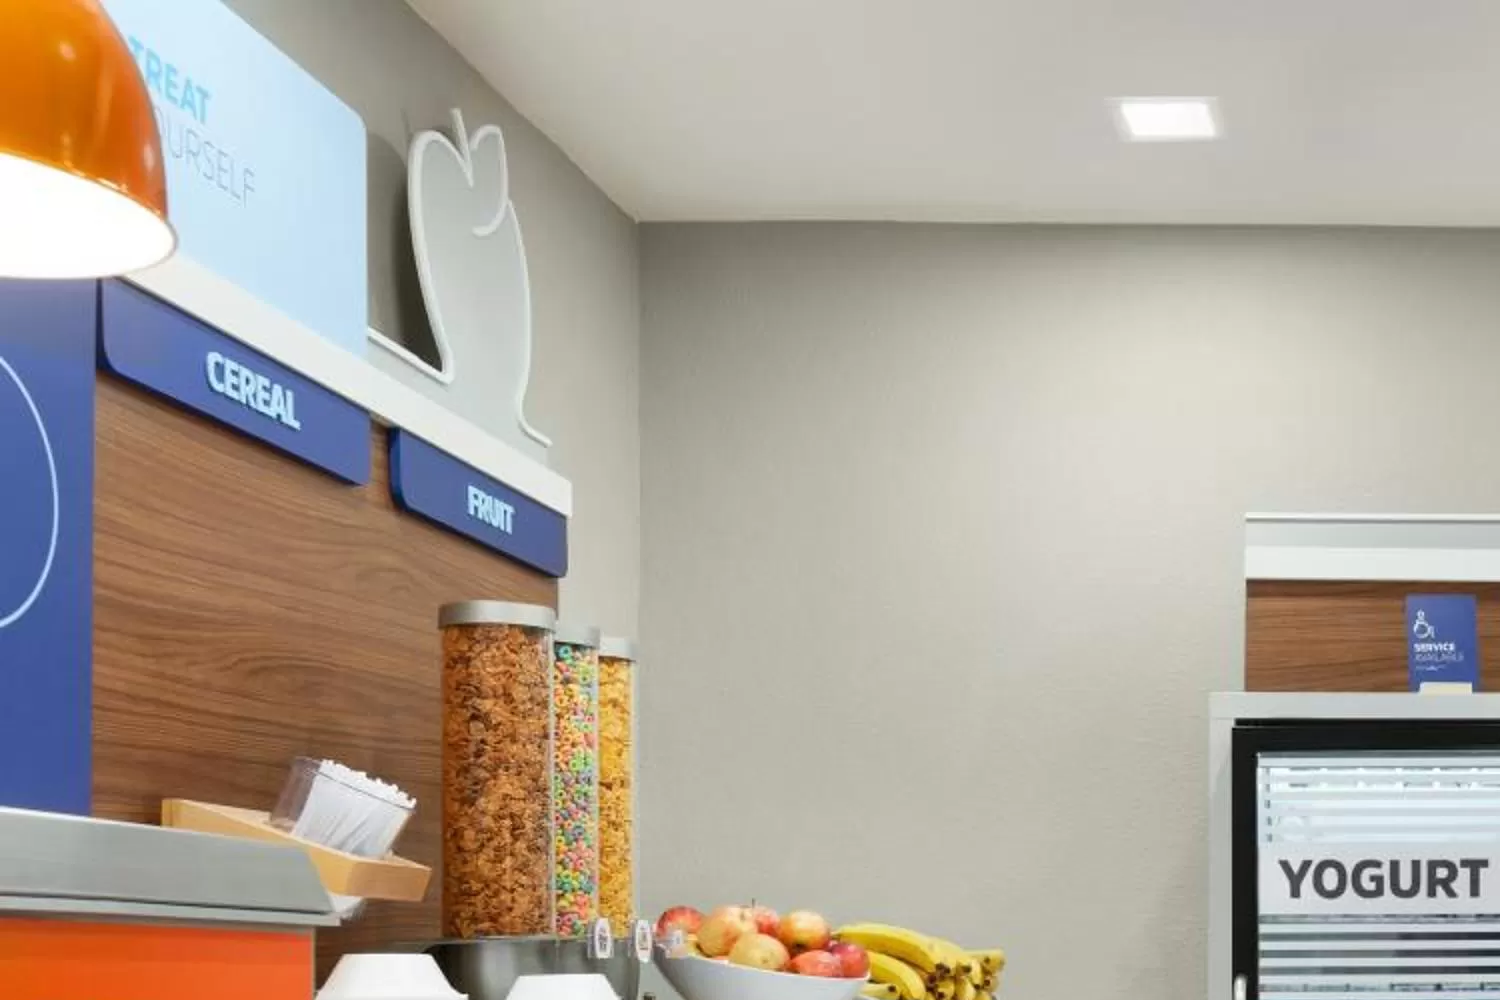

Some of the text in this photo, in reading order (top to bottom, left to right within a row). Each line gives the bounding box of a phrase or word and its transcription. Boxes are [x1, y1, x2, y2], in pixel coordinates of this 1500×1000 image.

[128, 35, 210, 124] TREAT
[205, 351, 301, 431] CEREAL
[466, 485, 515, 535] FRUIT
[1278, 858, 1489, 900] YOGURT
